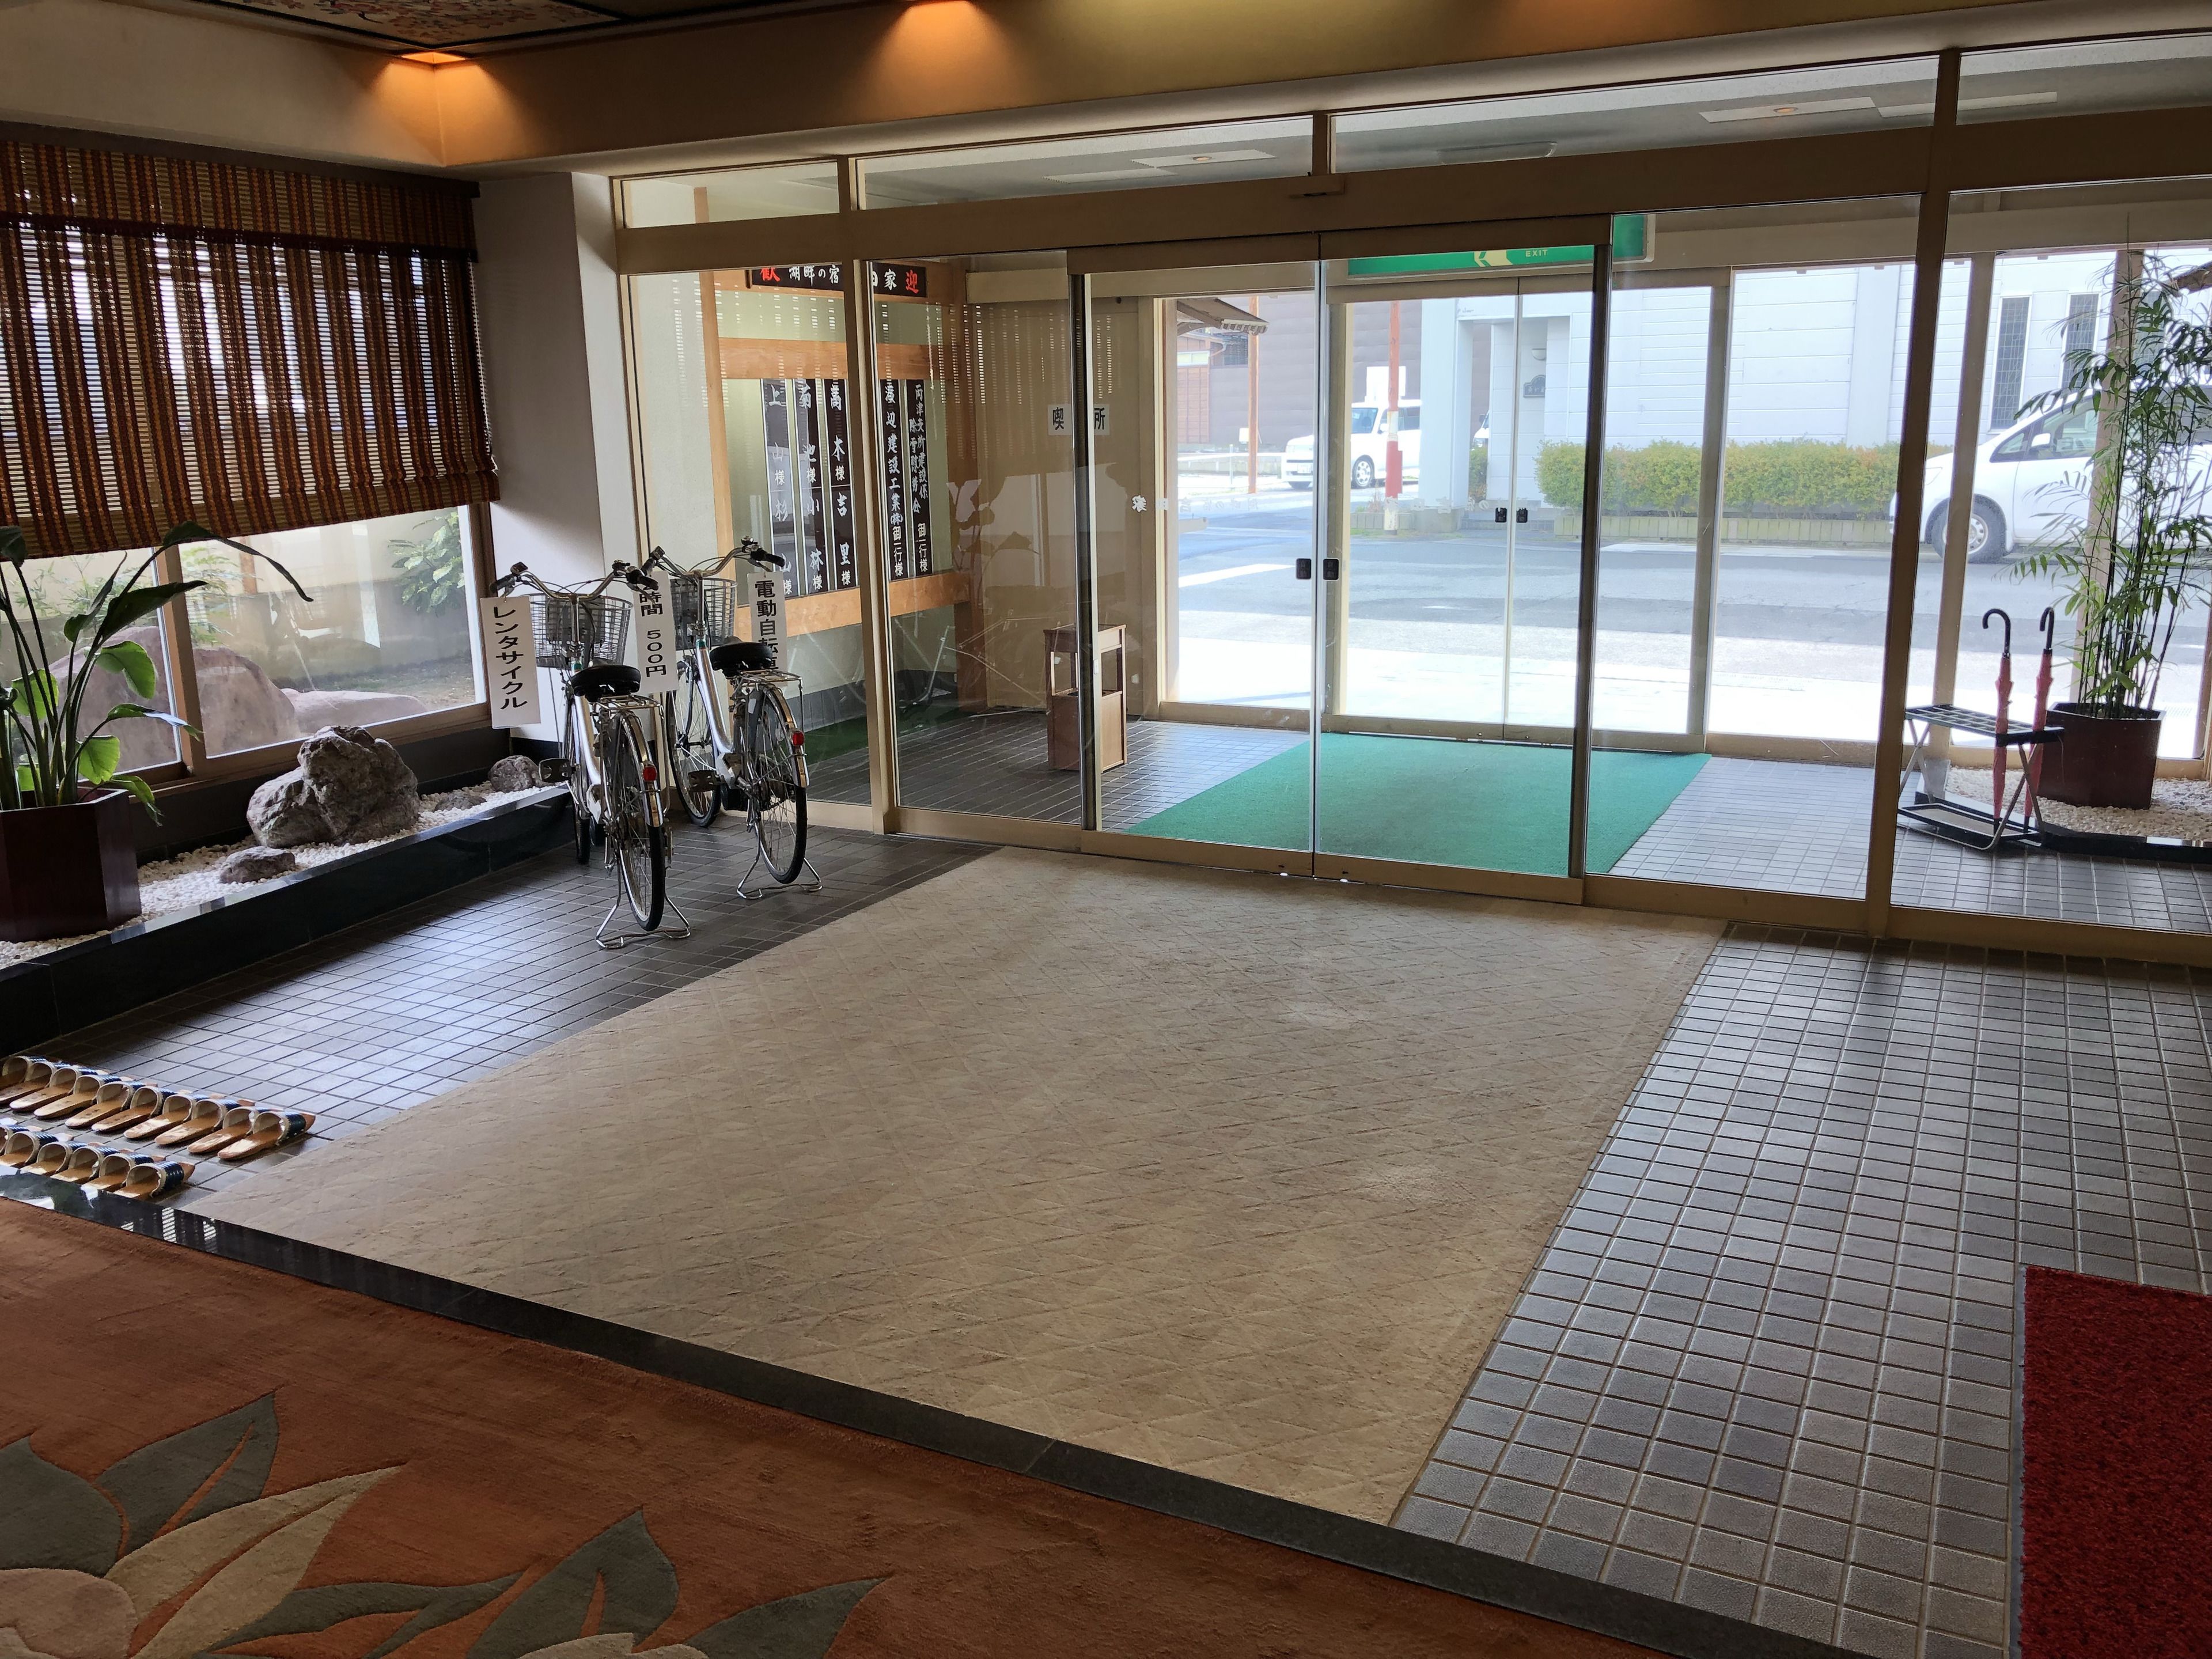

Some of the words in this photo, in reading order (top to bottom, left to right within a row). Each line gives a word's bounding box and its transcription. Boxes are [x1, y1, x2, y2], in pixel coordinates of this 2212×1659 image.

[789, 264, 840, 286] 湖畔の宿
[906, 269, 919, 294] 迎
[830, 384, 846, 482] 高木様
[639, 586, 664, 617] 時間
[493, 606, 528, 710] レンタサイクル
[645, 629, 667, 677] 500円
